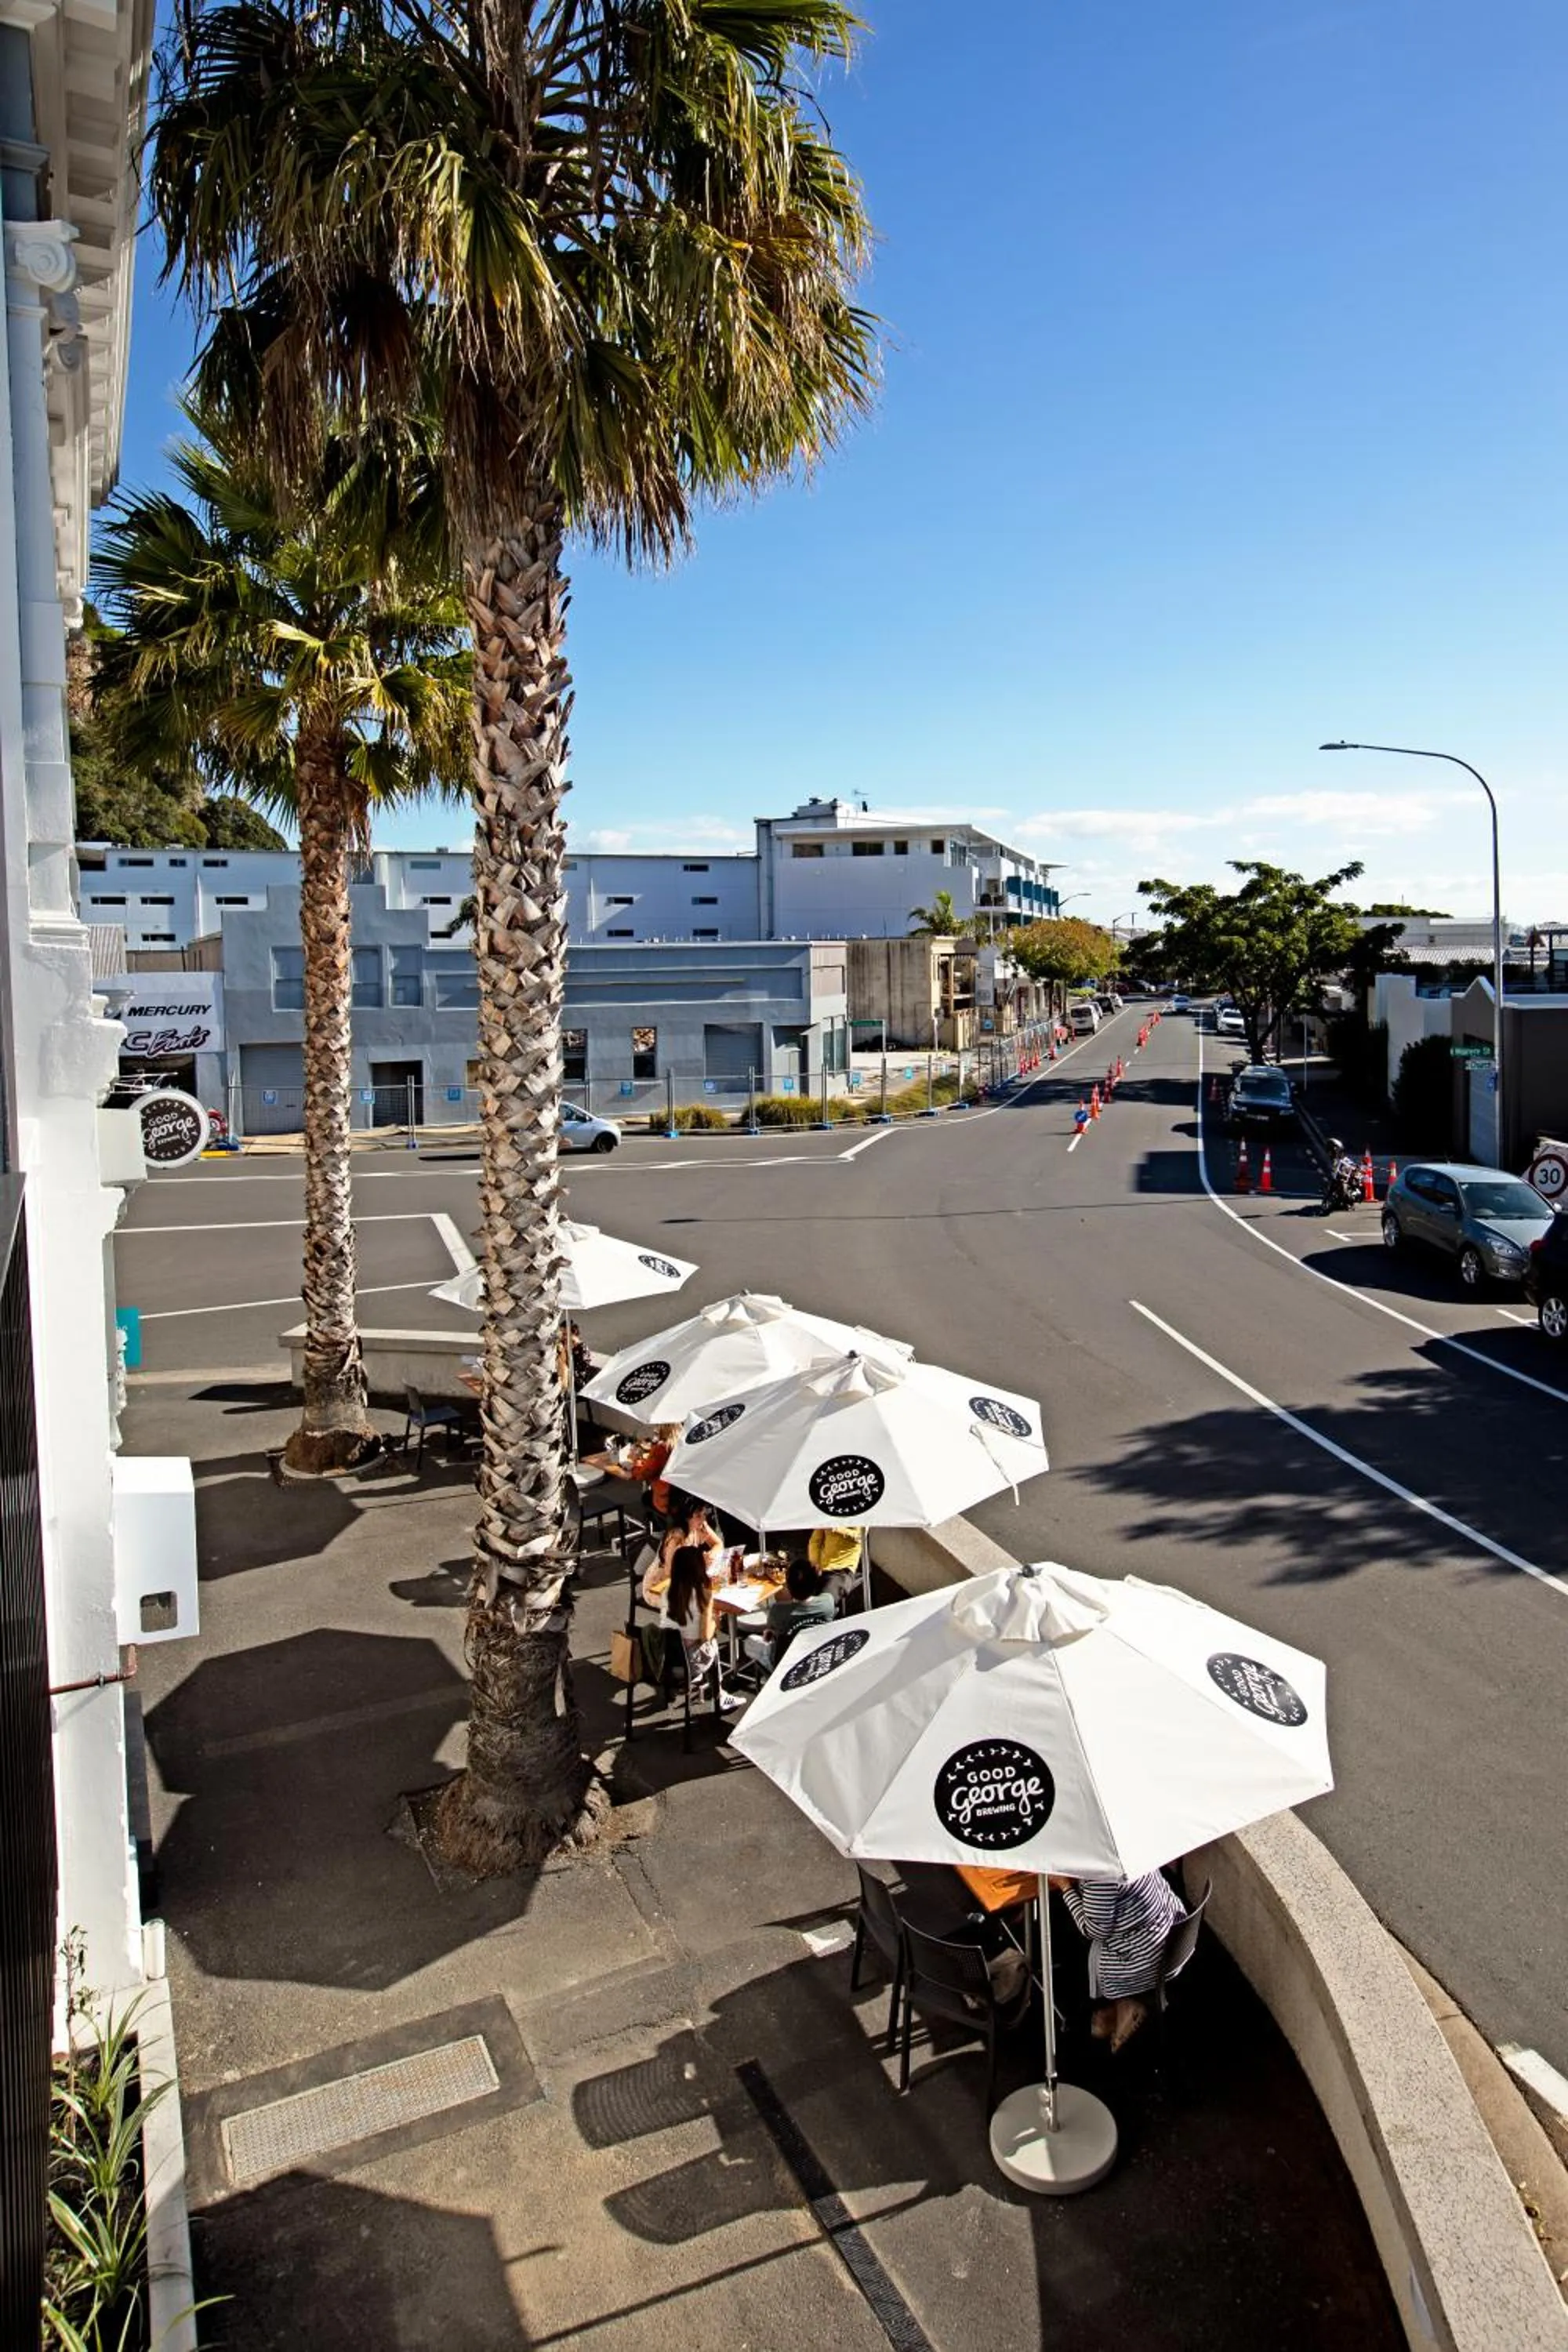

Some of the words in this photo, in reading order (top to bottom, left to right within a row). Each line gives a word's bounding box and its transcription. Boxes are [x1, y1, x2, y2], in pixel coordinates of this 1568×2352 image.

[128, 1004, 212, 1017] MERCURY
[148, 1112, 178, 1127] GOOD
[143, 1116, 196, 1150] George
[1538, 1167, 1561, 1185] 30
[819, 1473, 878, 1504] George
[967, 1766, 1016, 1784] GOOD
[951, 1776, 1044, 1824] George
[976, 1802, 1017, 1817] BREWING
